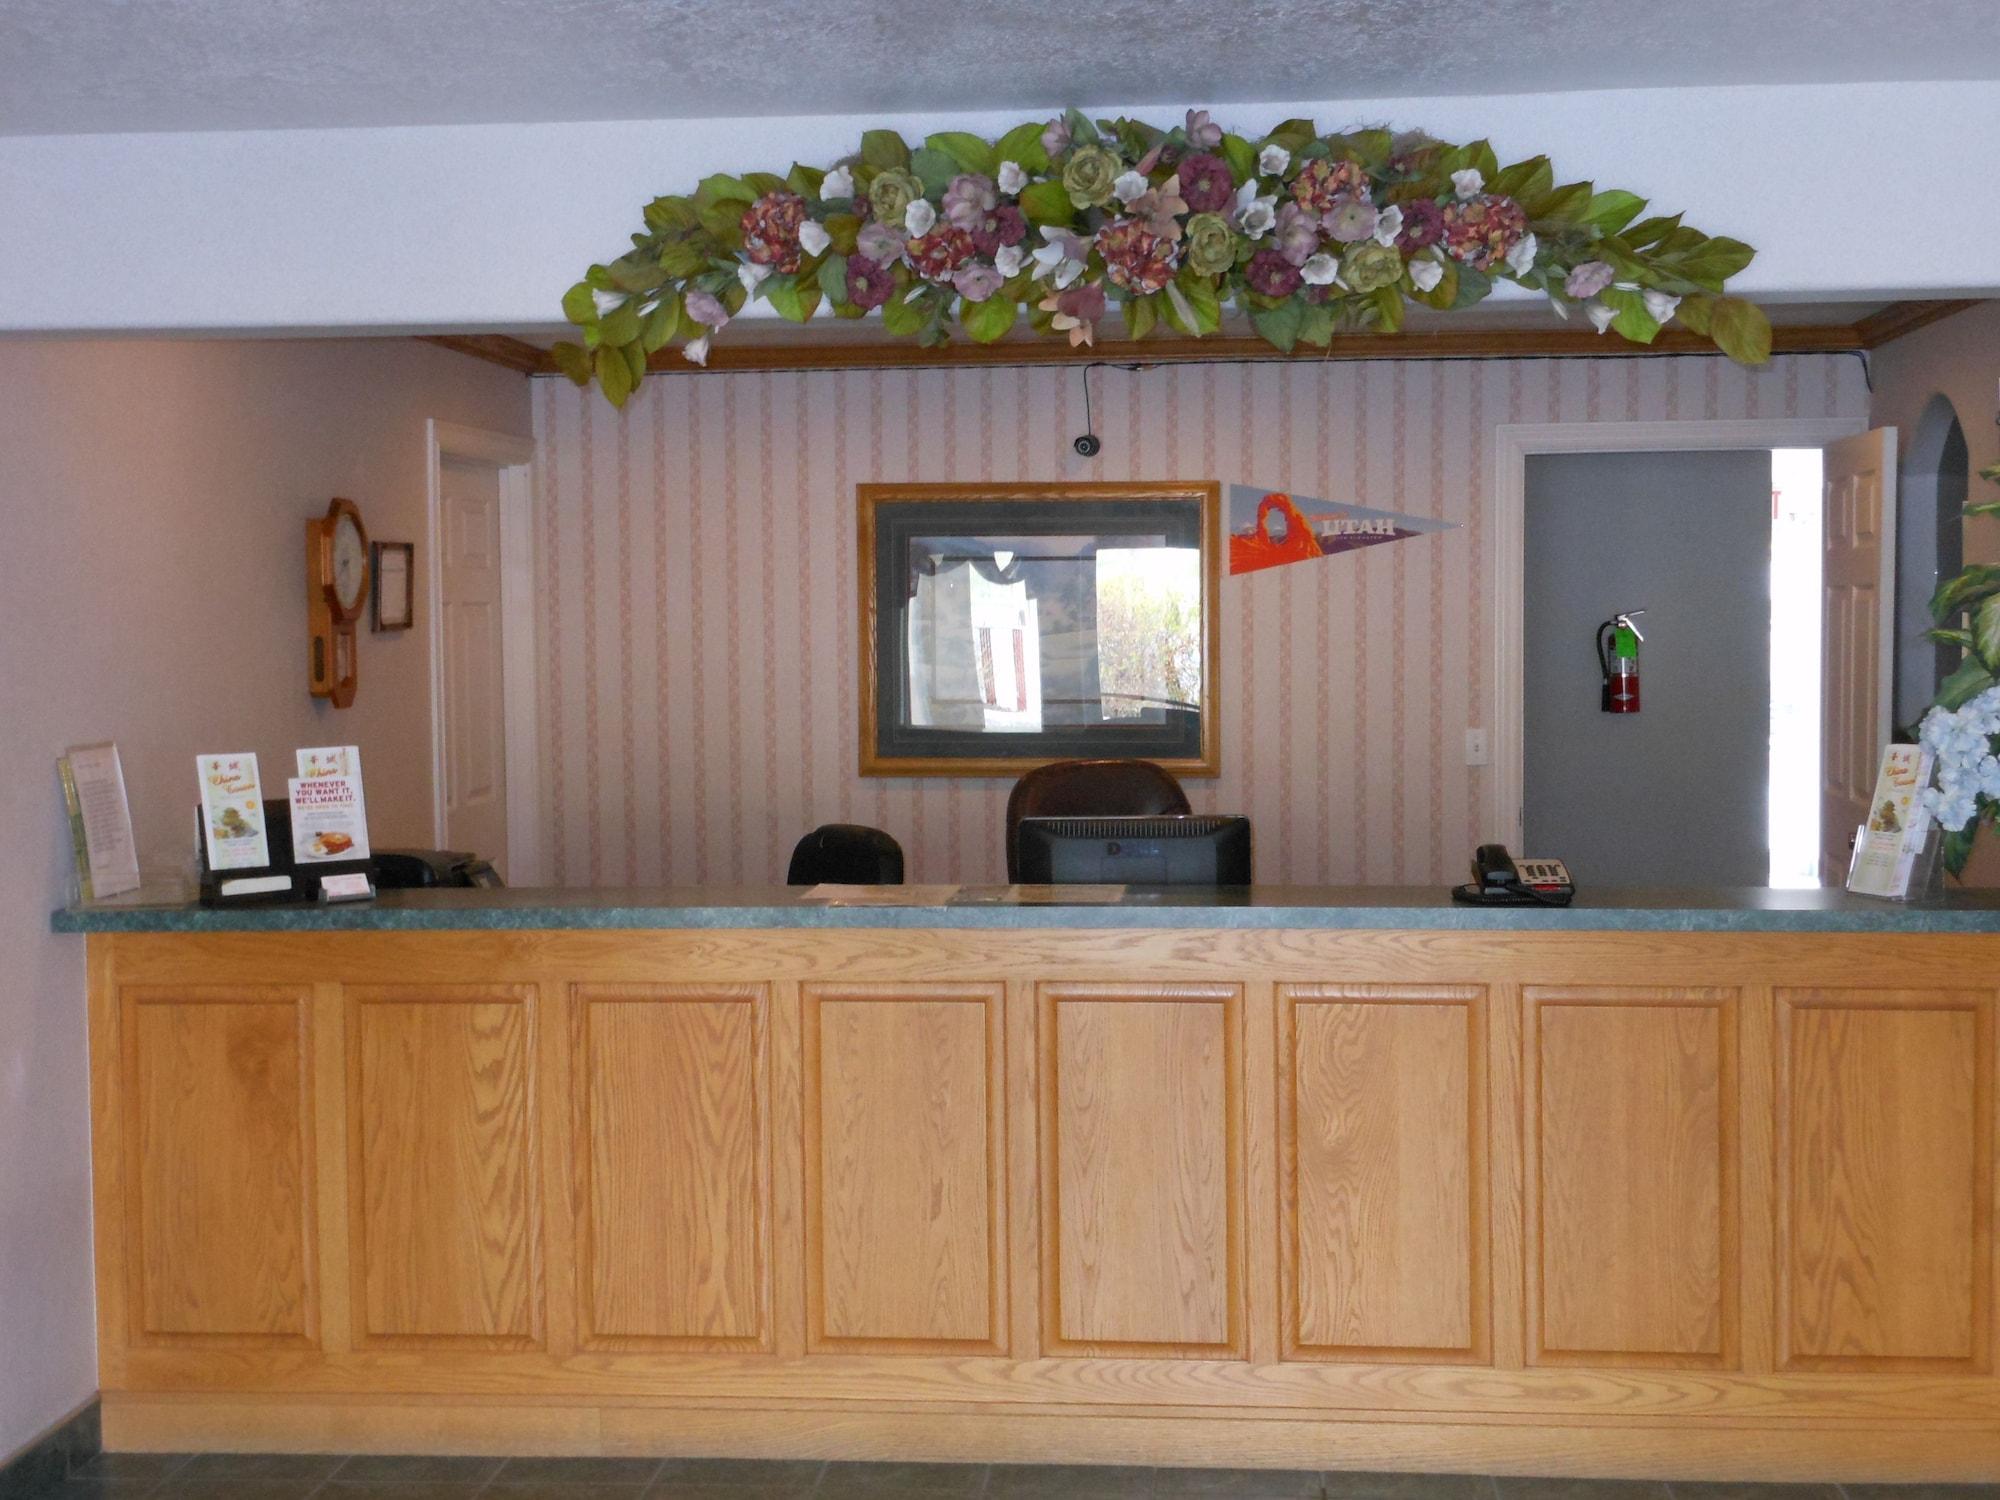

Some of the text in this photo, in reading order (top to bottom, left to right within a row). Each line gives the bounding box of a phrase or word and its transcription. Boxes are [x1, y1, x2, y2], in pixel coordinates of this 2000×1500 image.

[1321, 519, 1396, 536] UTAH
[300, 781, 346, 789] WHENEVER
[316, 787, 339, 795] WANT
[295, 796, 319, 804] WE'LL
[320, 795, 344, 803] MAKE
